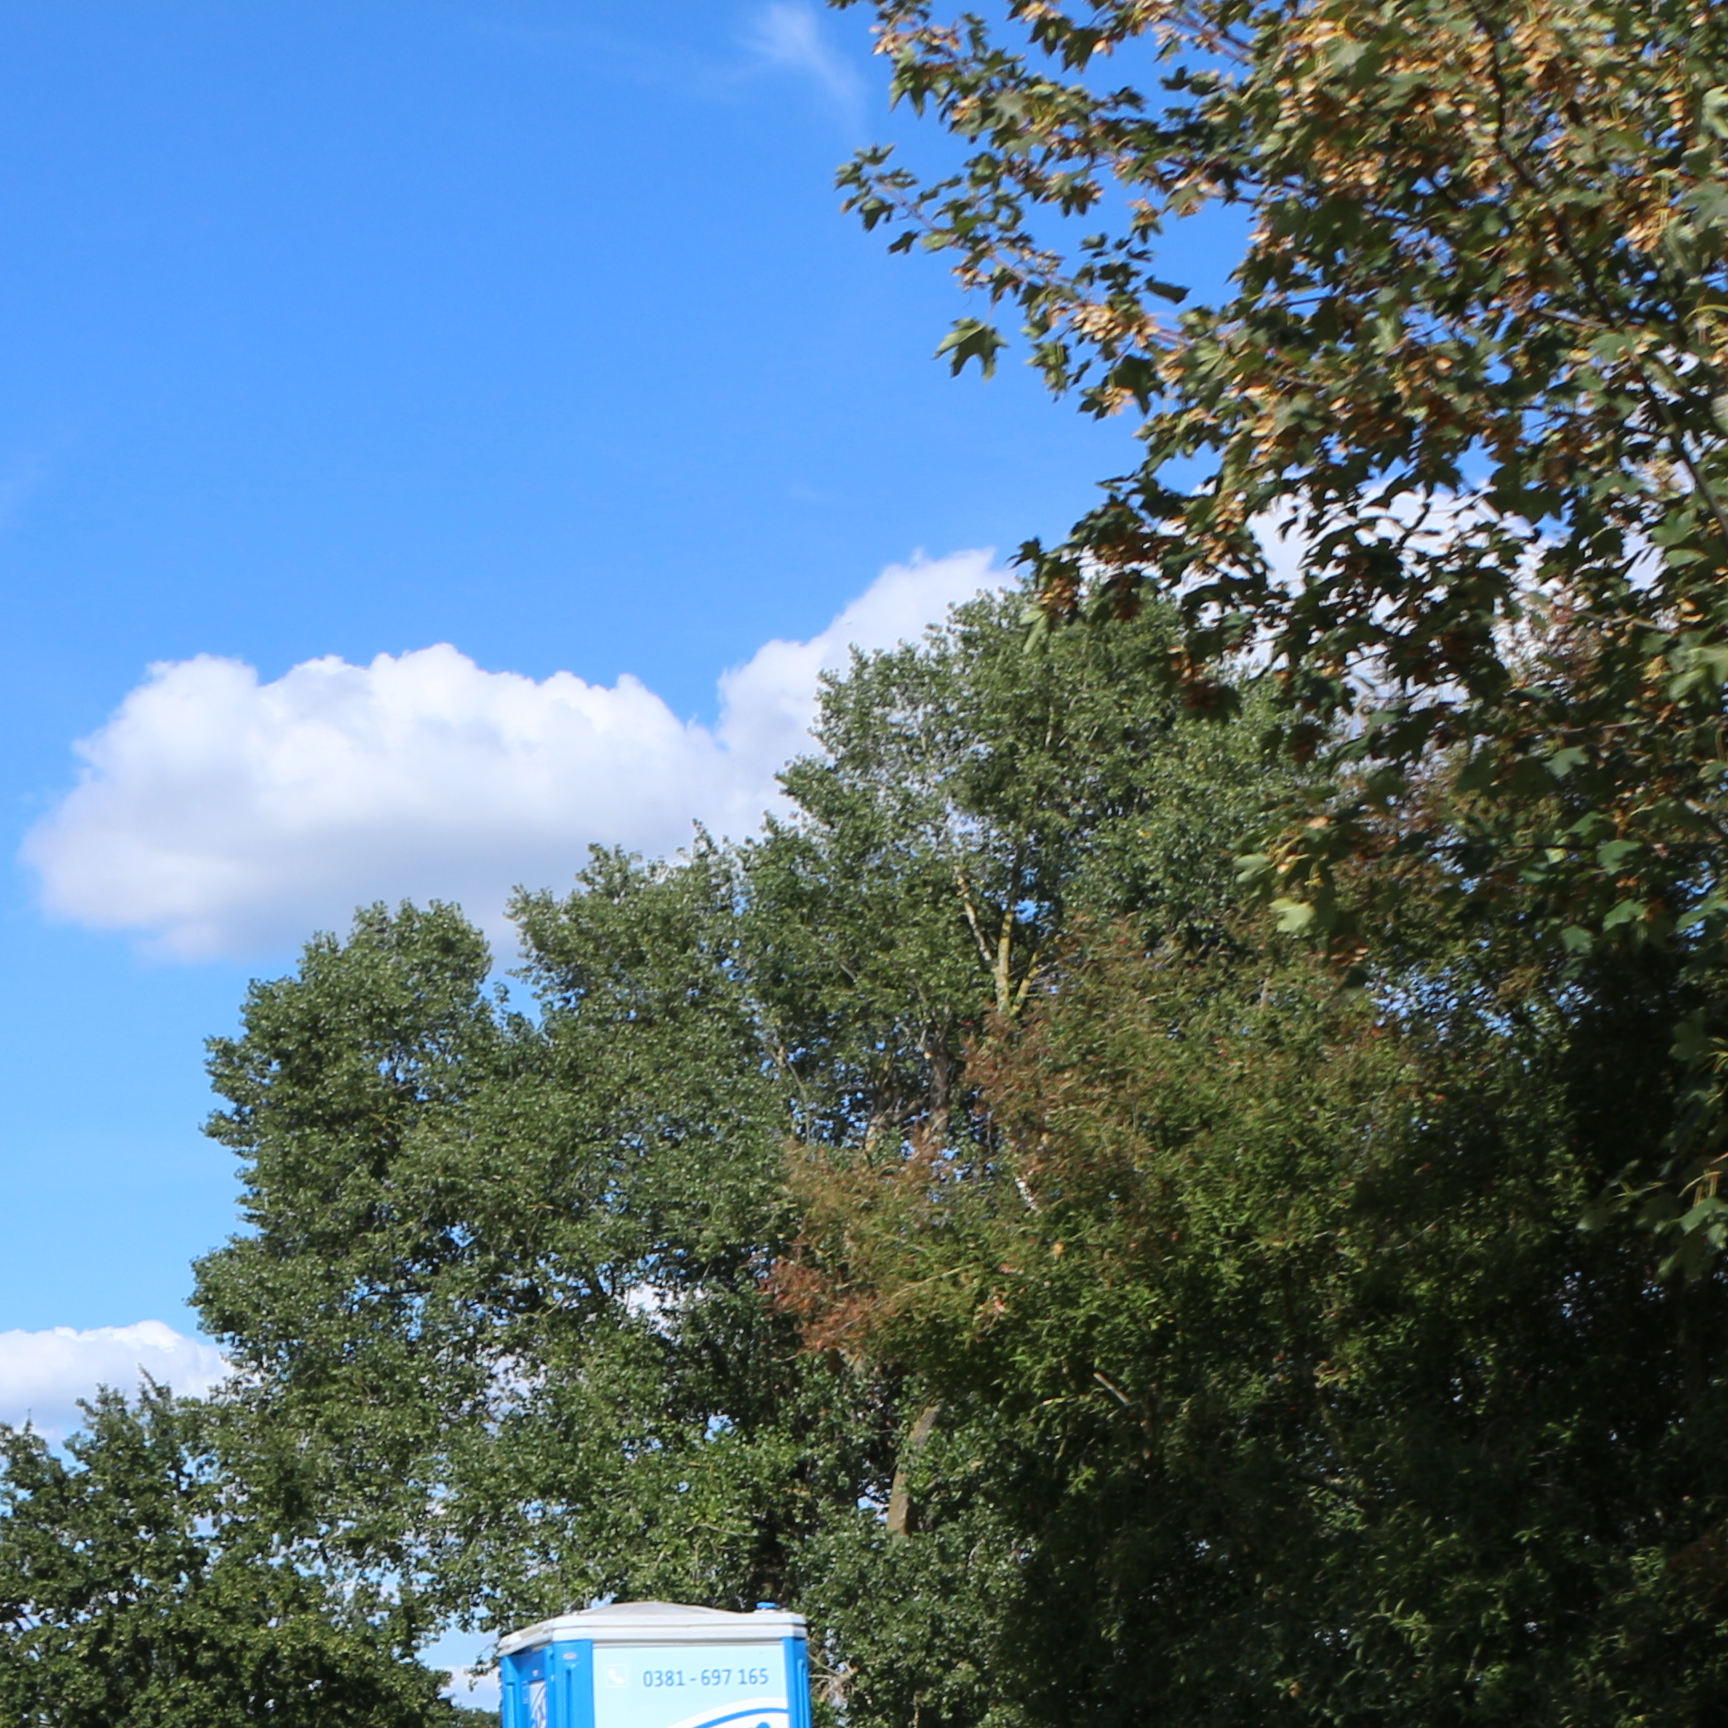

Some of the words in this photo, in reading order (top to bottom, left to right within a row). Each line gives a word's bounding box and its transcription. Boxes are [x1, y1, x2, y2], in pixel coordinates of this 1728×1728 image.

[643, 1670, 685, 1687] 0381
[700, 1669, 732, 1686] 697
[738, 1668, 769, 1685] 165
